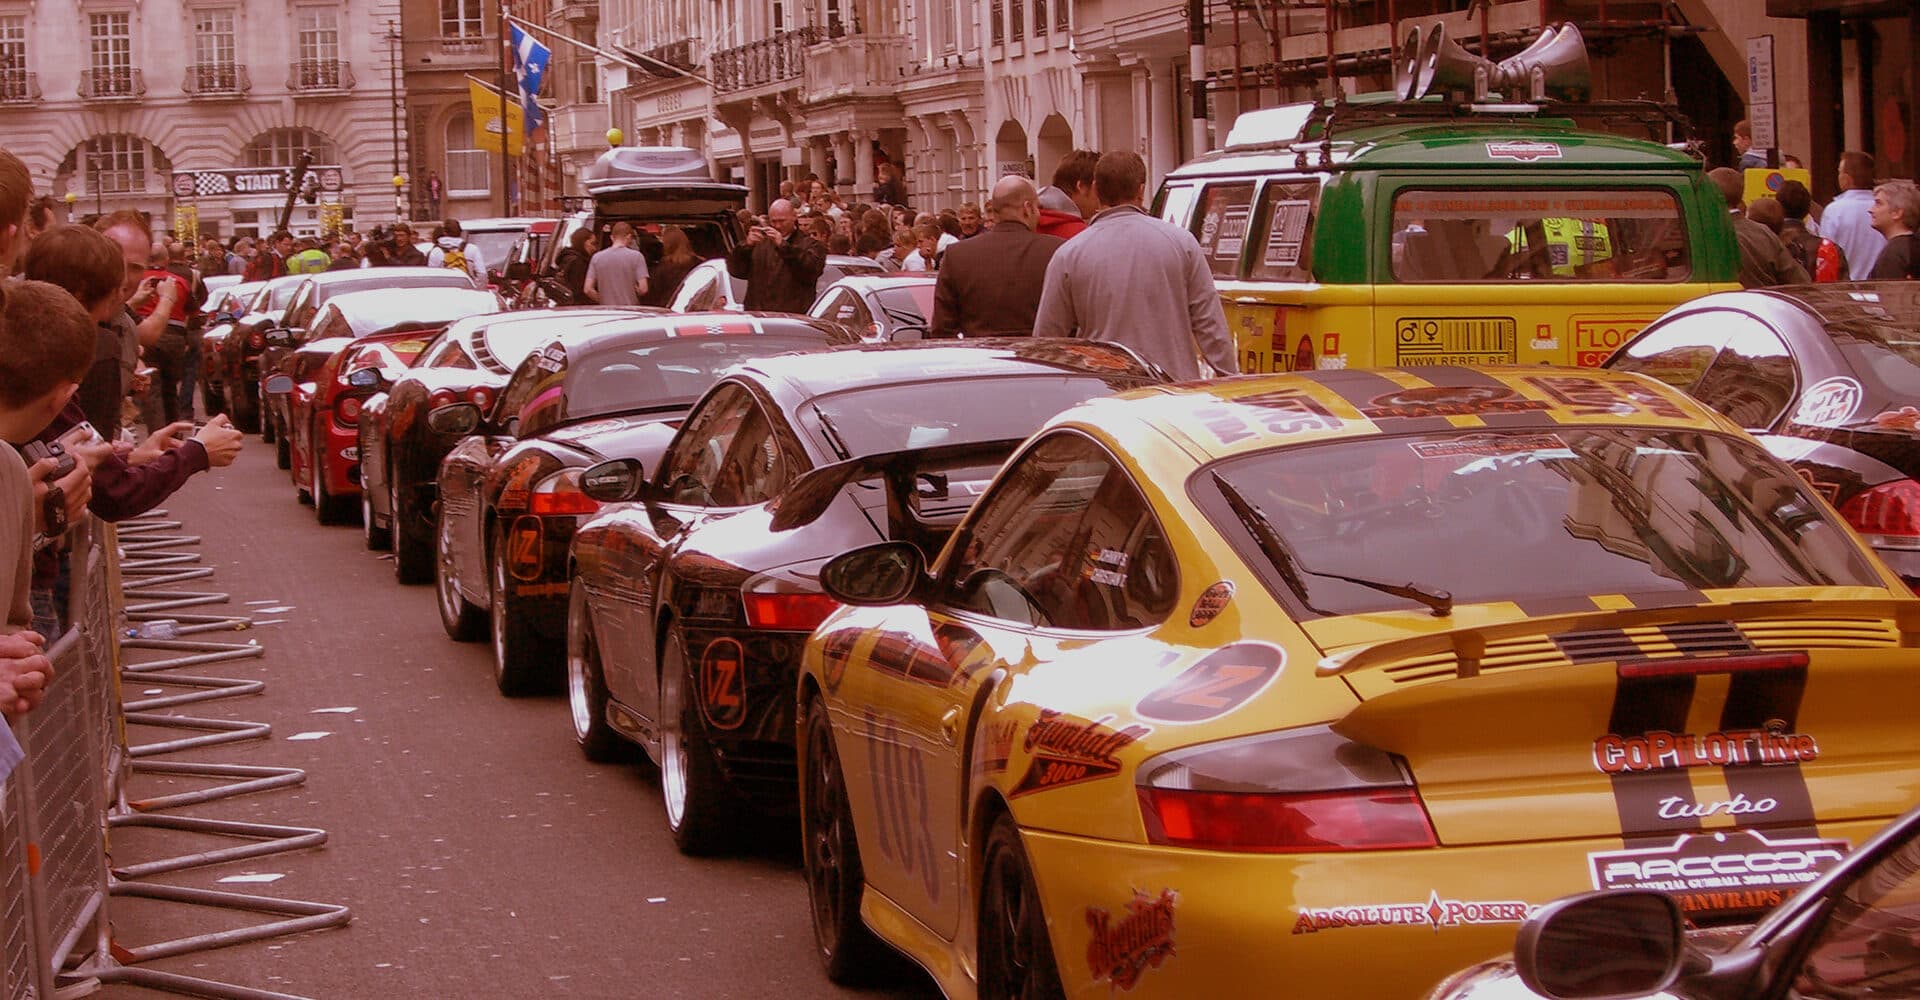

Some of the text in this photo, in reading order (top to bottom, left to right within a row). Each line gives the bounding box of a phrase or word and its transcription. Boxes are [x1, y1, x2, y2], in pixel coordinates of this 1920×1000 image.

[234, 174, 281, 191] START
[1657, 793, 1778, 819] turbo
[1291, 902, 1528, 935] ABSOLUTE POKER
